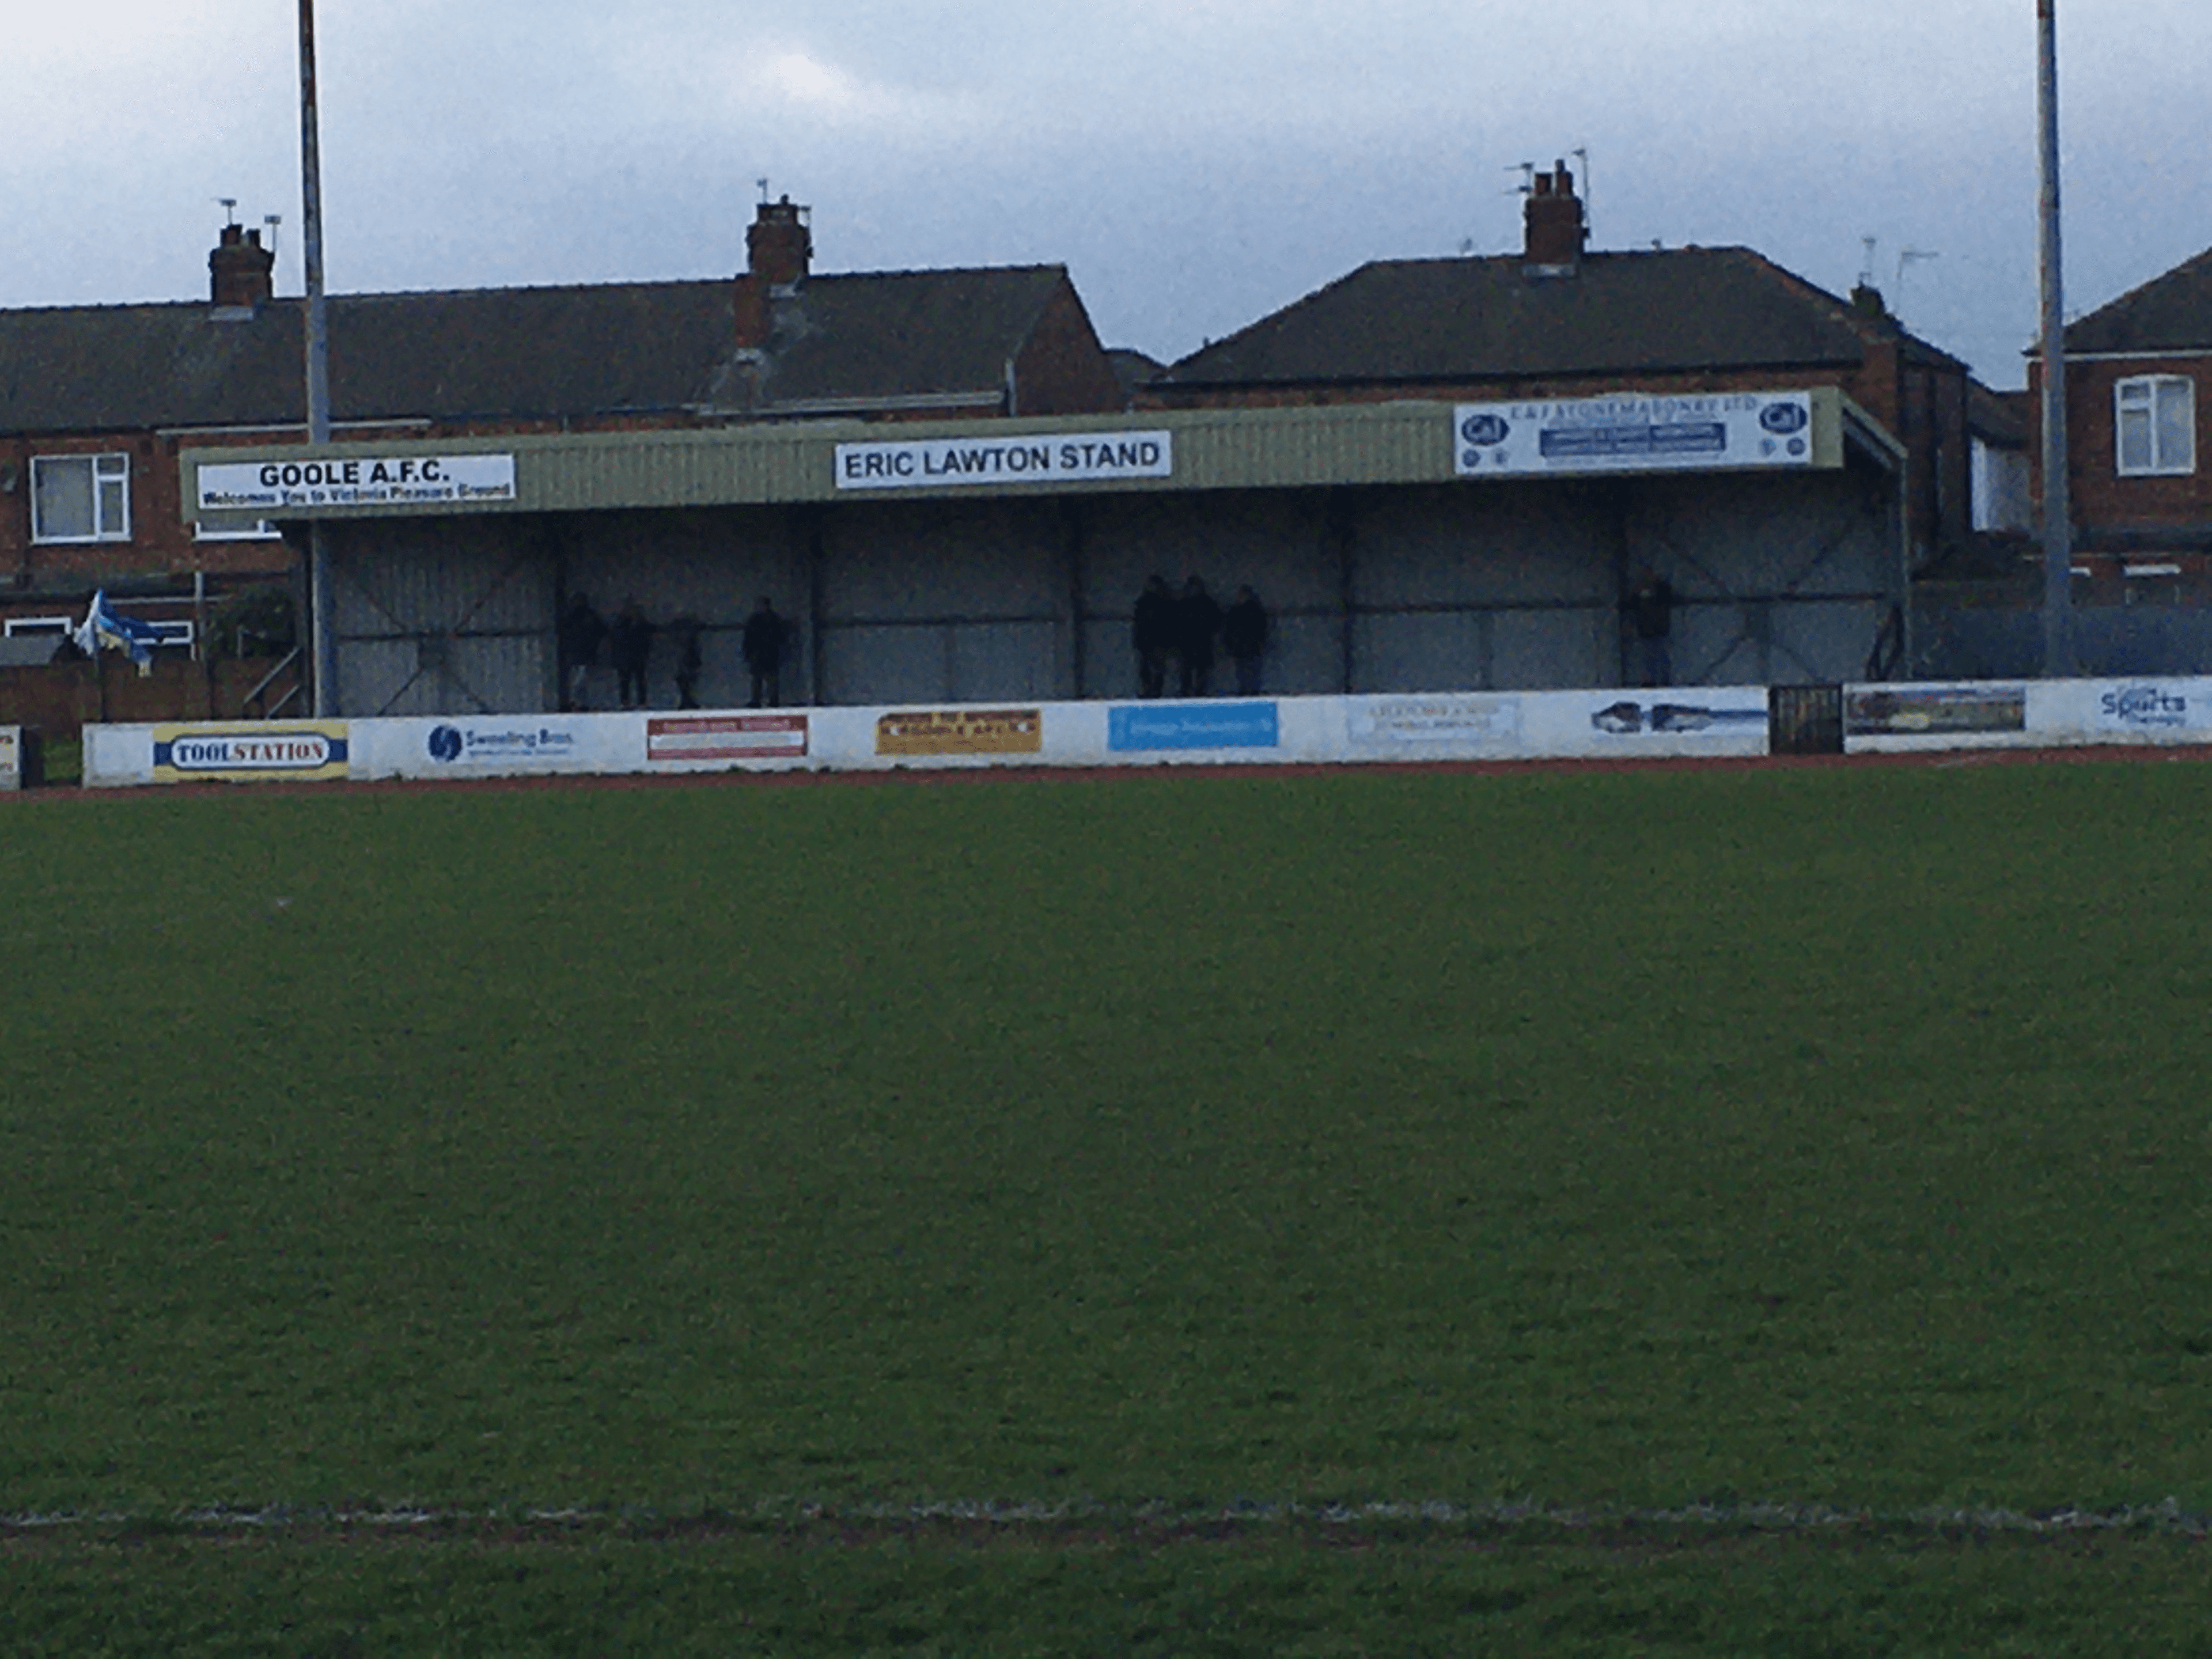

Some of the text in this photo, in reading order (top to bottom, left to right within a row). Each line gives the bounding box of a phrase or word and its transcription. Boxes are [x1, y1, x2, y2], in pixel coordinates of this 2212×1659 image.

[844, 442, 1160, 479] ERIC LAWTON STAND
[260, 461, 449, 487] GOOLE A.F.C.
[310, 490, 325, 503] to
[176, 742, 323, 762] TOOLSTATION
